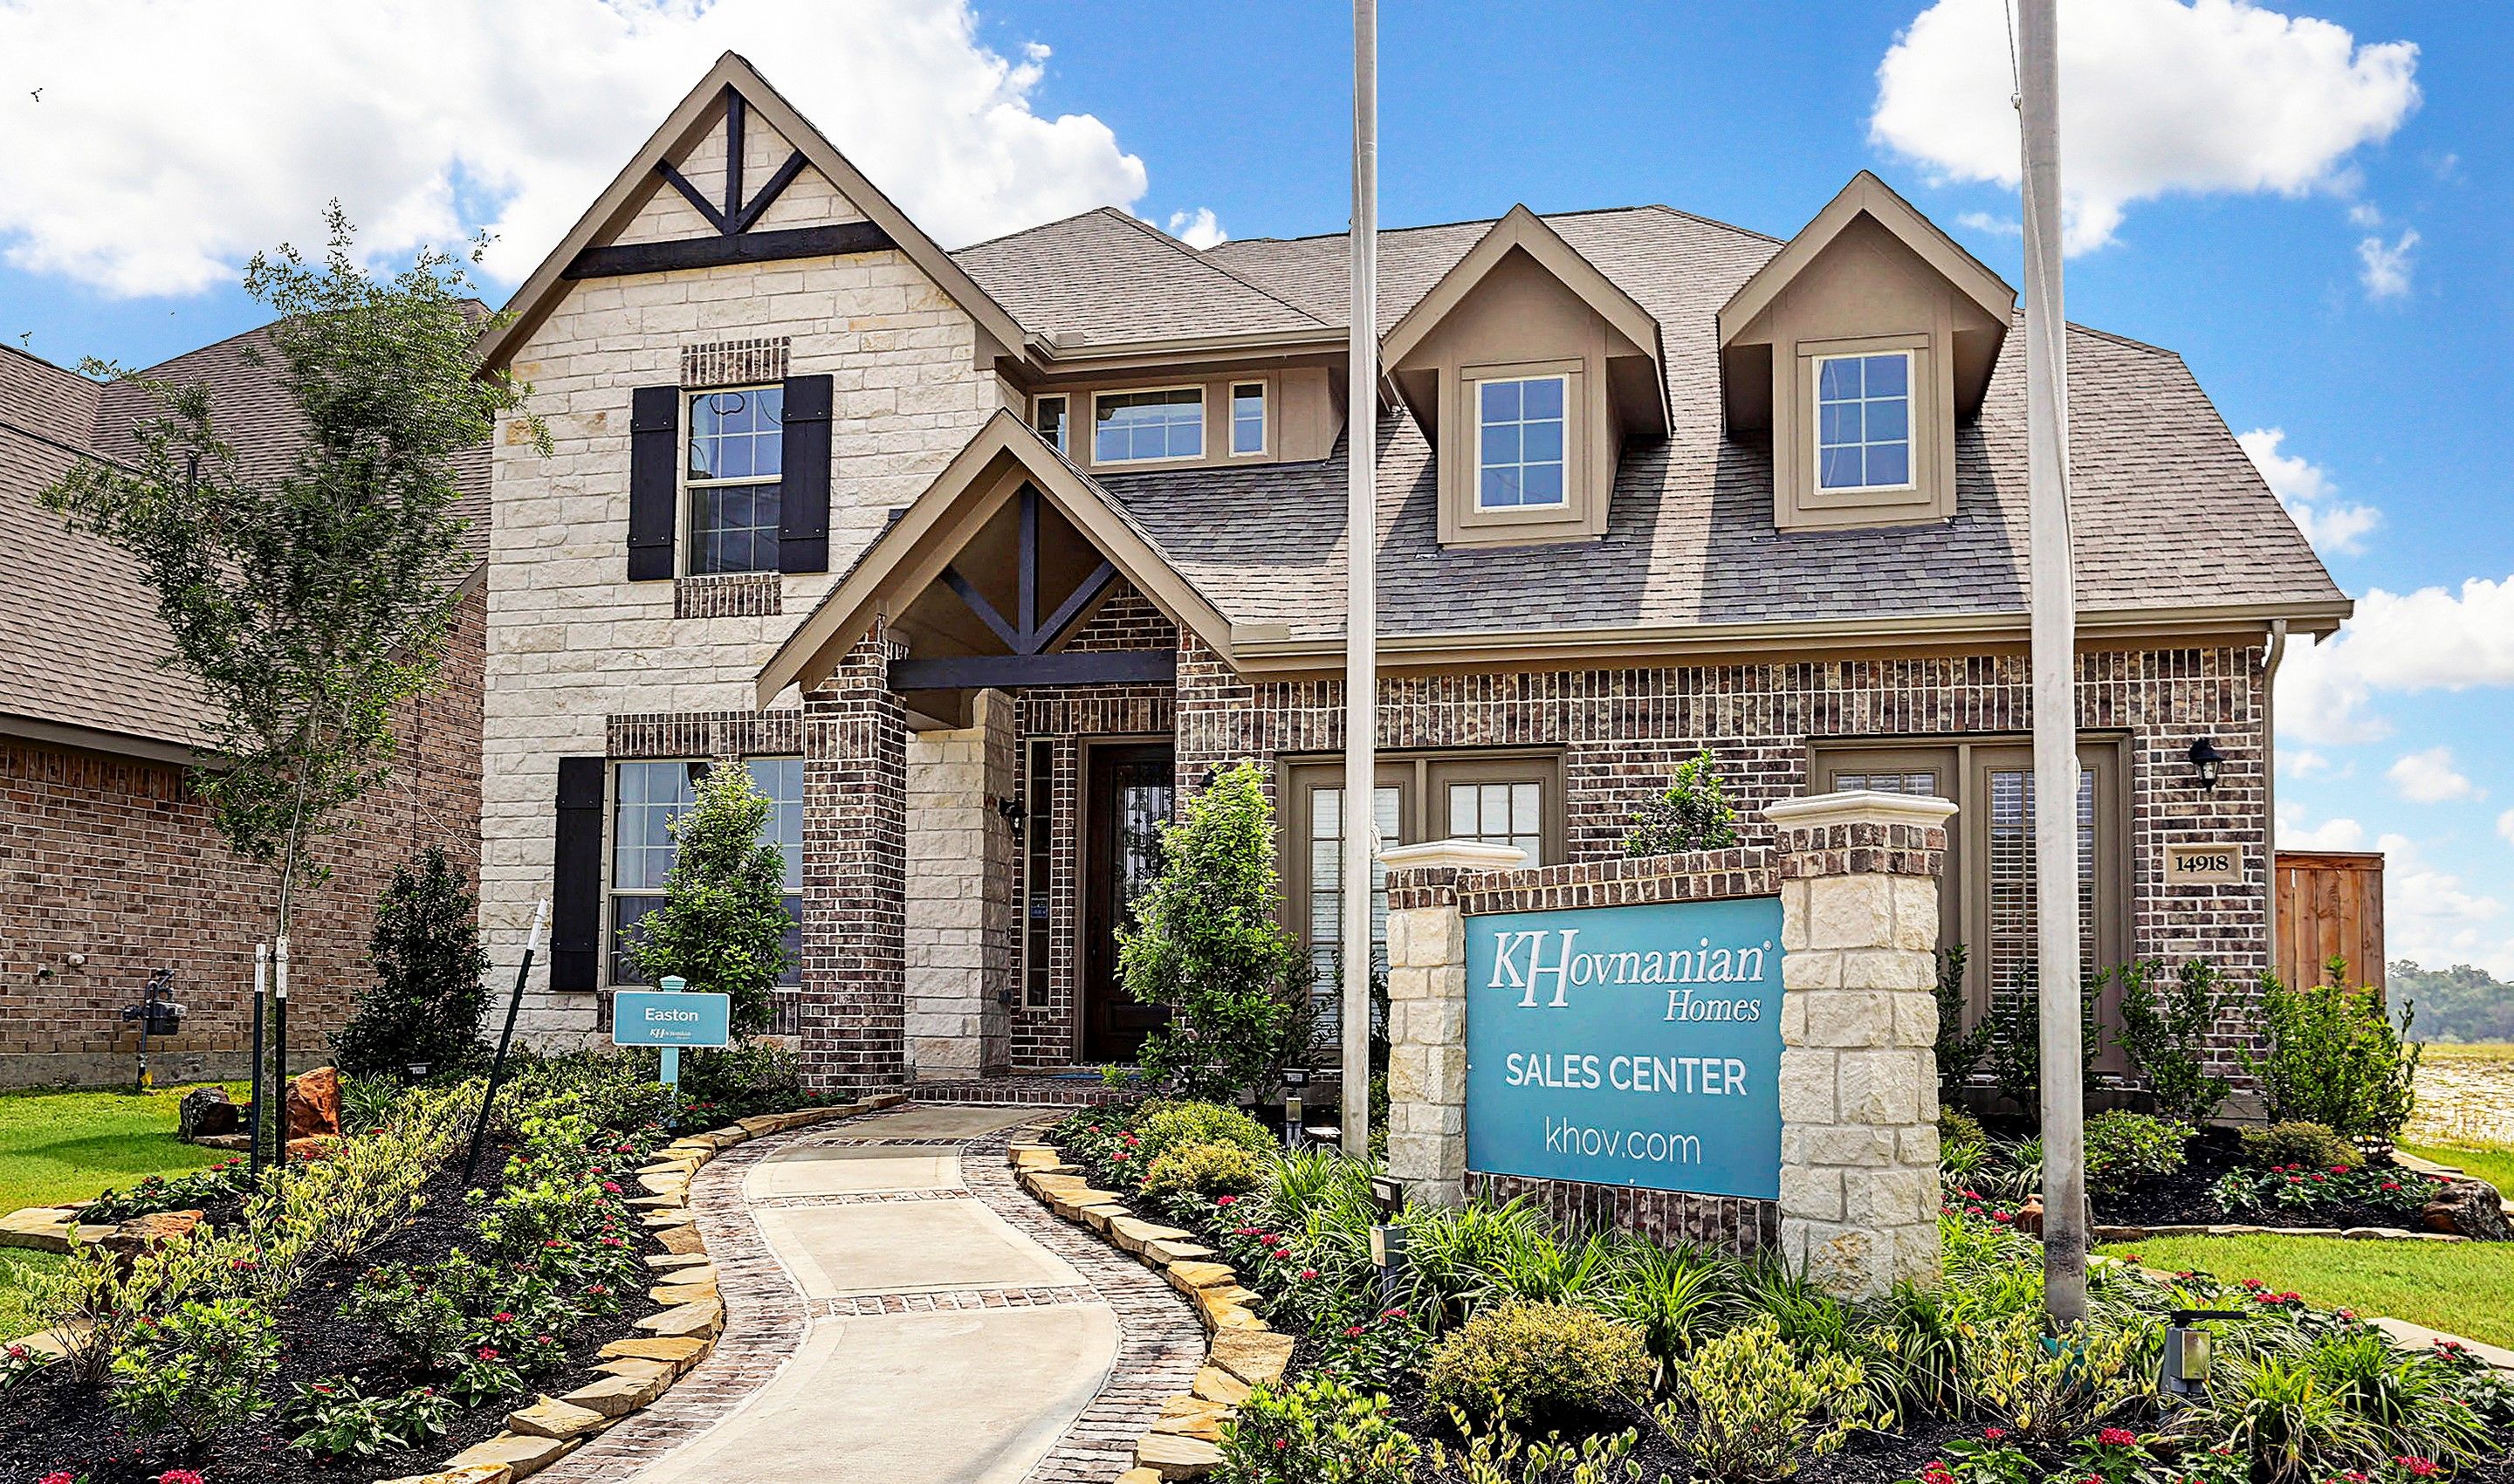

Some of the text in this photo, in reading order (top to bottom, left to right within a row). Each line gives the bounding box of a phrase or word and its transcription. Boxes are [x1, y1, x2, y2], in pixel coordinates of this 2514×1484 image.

[2175, 855, 2229, 872] 14918
[644, 1007, 699, 1021] Easton
[1664, 989, 1762, 1022] Homes
[1505, 1053, 1748, 1096] SALES CENTER
[1545, 1116, 1701, 1165] khov.com
